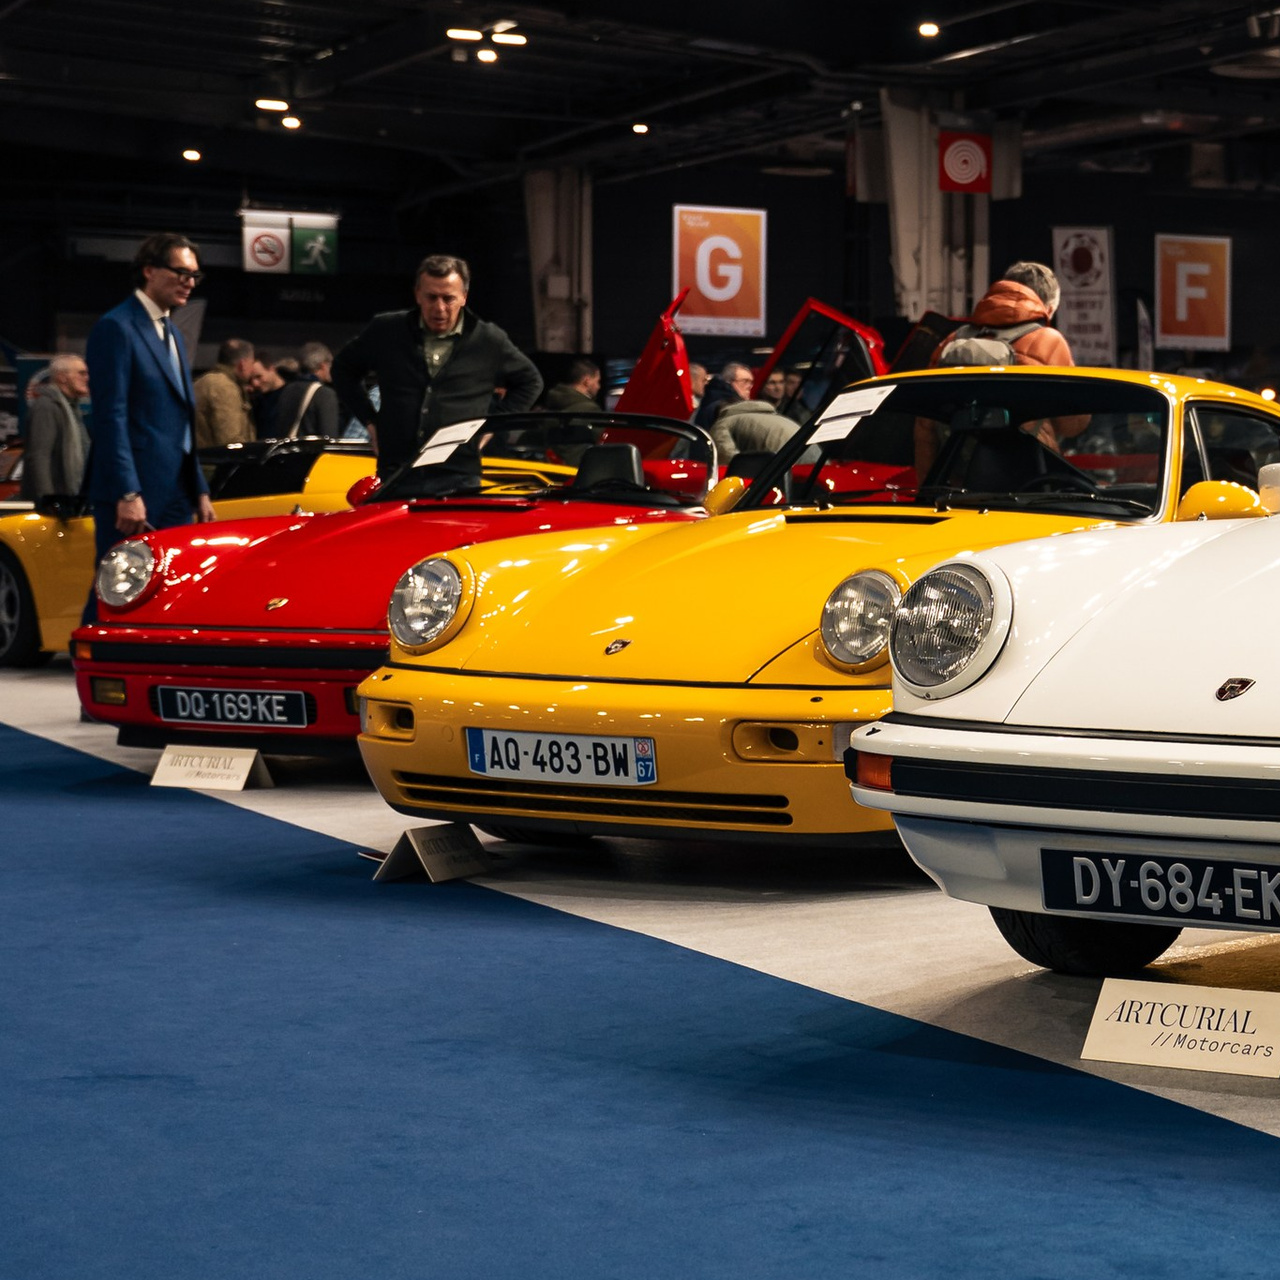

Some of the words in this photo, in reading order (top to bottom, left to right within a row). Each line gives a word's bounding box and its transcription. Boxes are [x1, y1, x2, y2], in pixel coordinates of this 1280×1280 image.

[695, 234, 744, 302] G
[1175, 261, 1211, 322] F
[175, 690, 288, 722] DQ-169-KE
[489, 735, 630, 778] AQ-483-BW
[637, 761, 653, 778] 67
[1105, 999, 1258, 1035] ARTCURIAL
